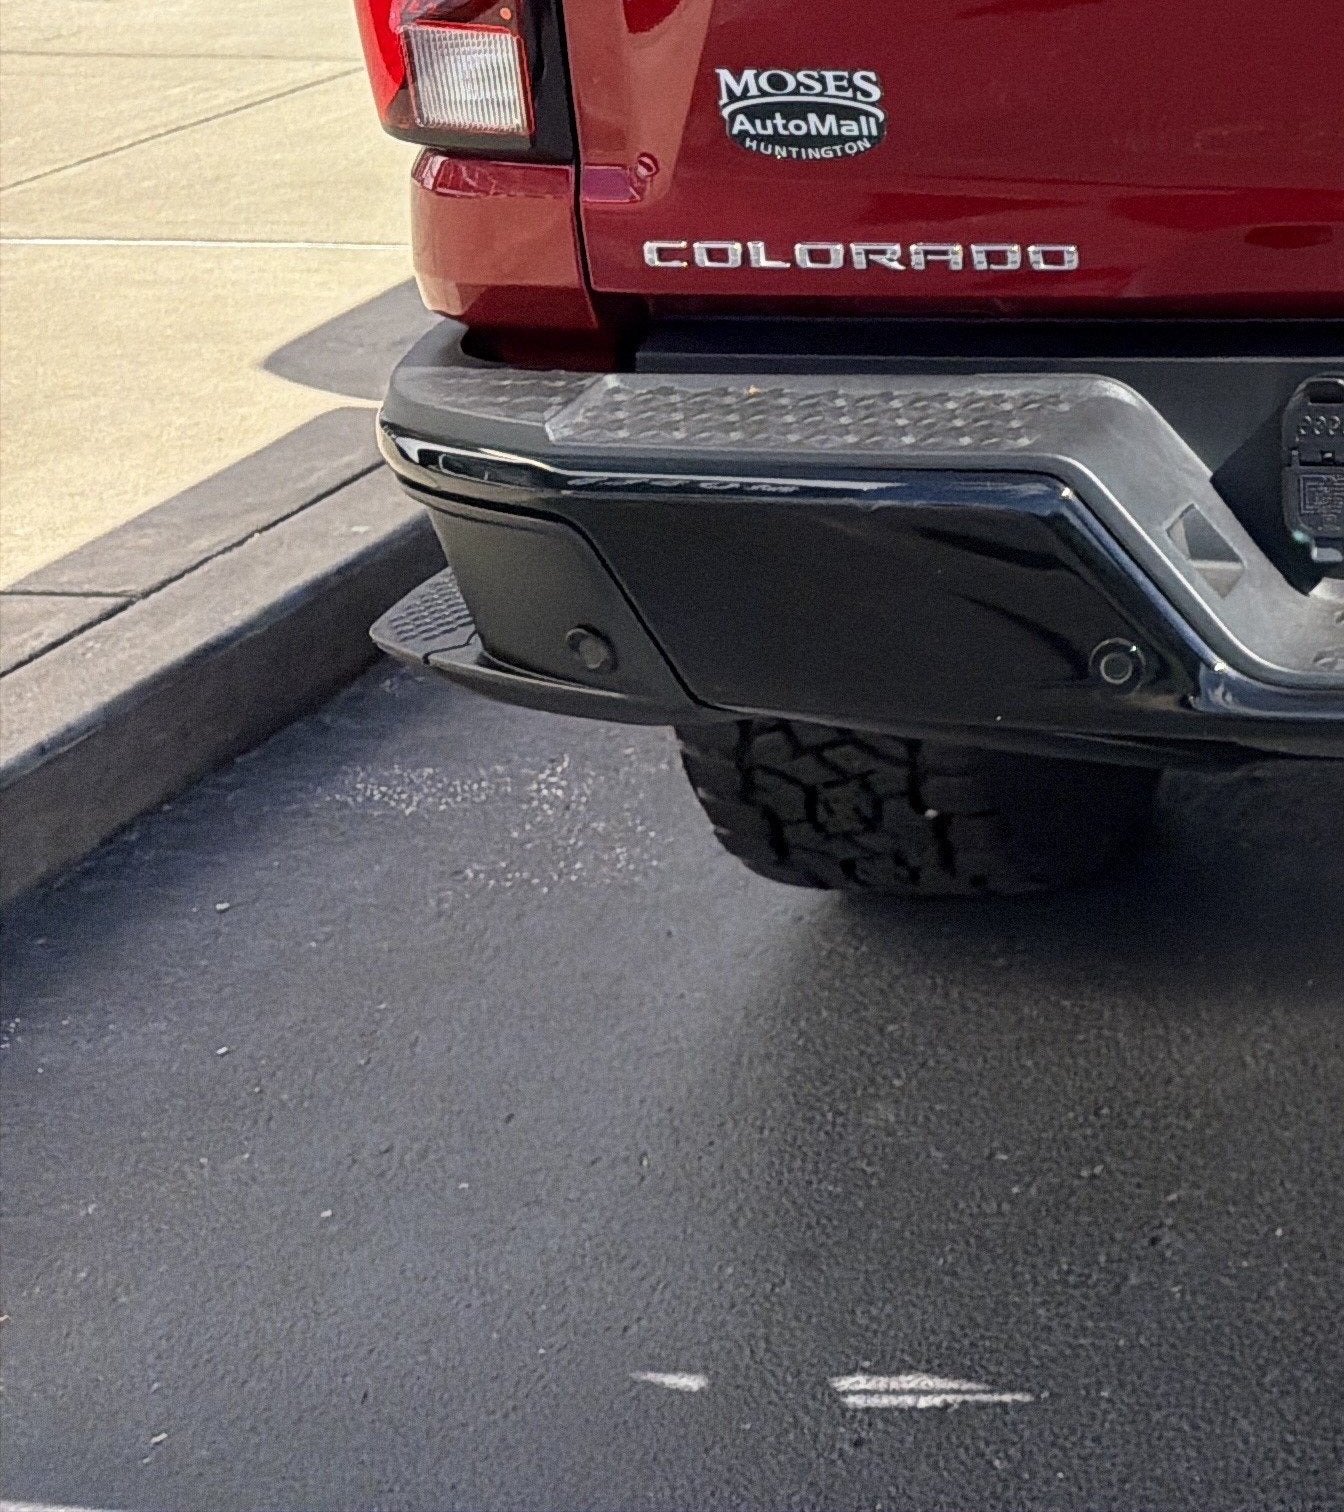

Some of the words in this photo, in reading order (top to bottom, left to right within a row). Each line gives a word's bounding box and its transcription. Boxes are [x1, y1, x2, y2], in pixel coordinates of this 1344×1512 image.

[715, 68, 882, 106] MOSES
[731, 112, 878, 136] AutoMall
[745, 137, 872, 160] HUNTINGTON
[643, 240, 1080, 271] COLORADO
